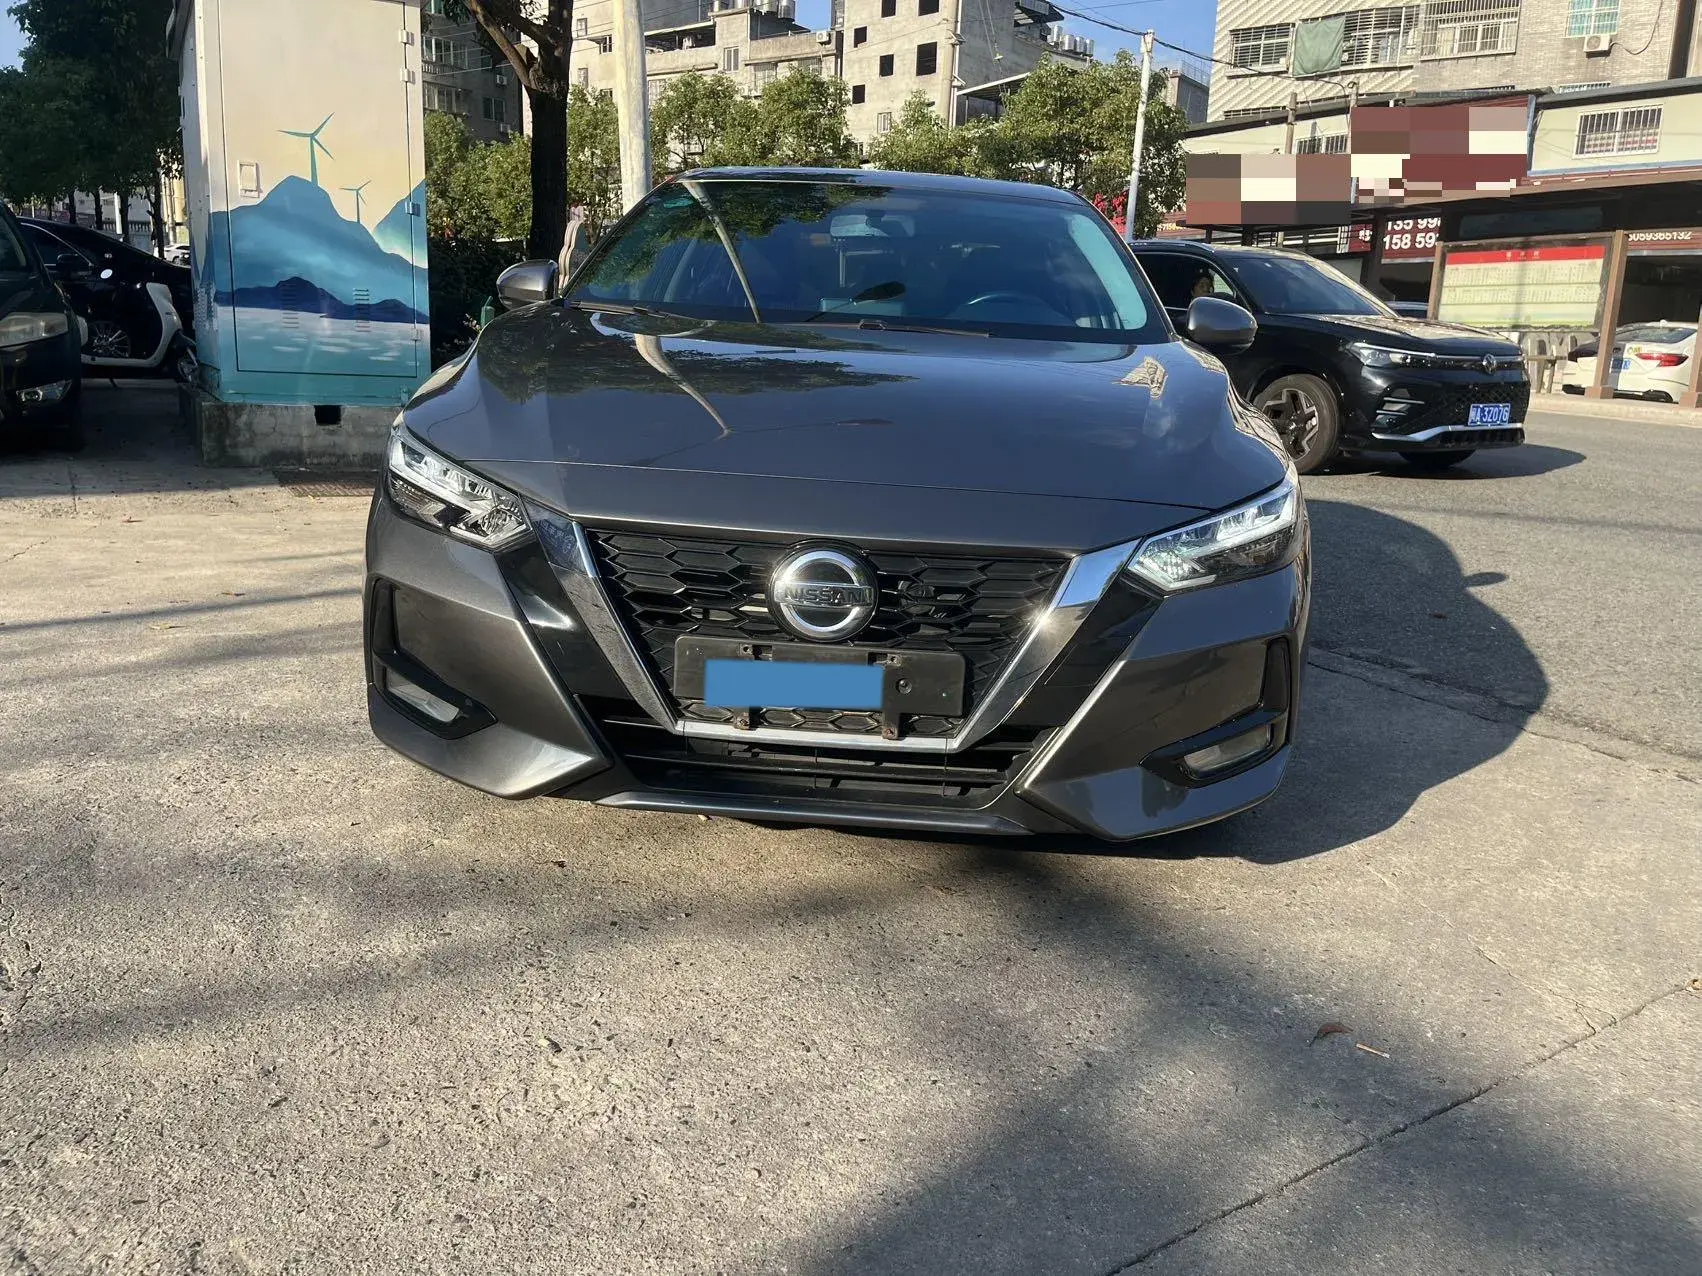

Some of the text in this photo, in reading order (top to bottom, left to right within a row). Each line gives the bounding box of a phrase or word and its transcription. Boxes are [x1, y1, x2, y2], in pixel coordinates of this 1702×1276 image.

[1417, 218, 1441, 229] 99
[1383, 234, 1411, 250] 158
[1415, 232, 1439, 248] 59
[784, 586, 867, 605] NISSAN
